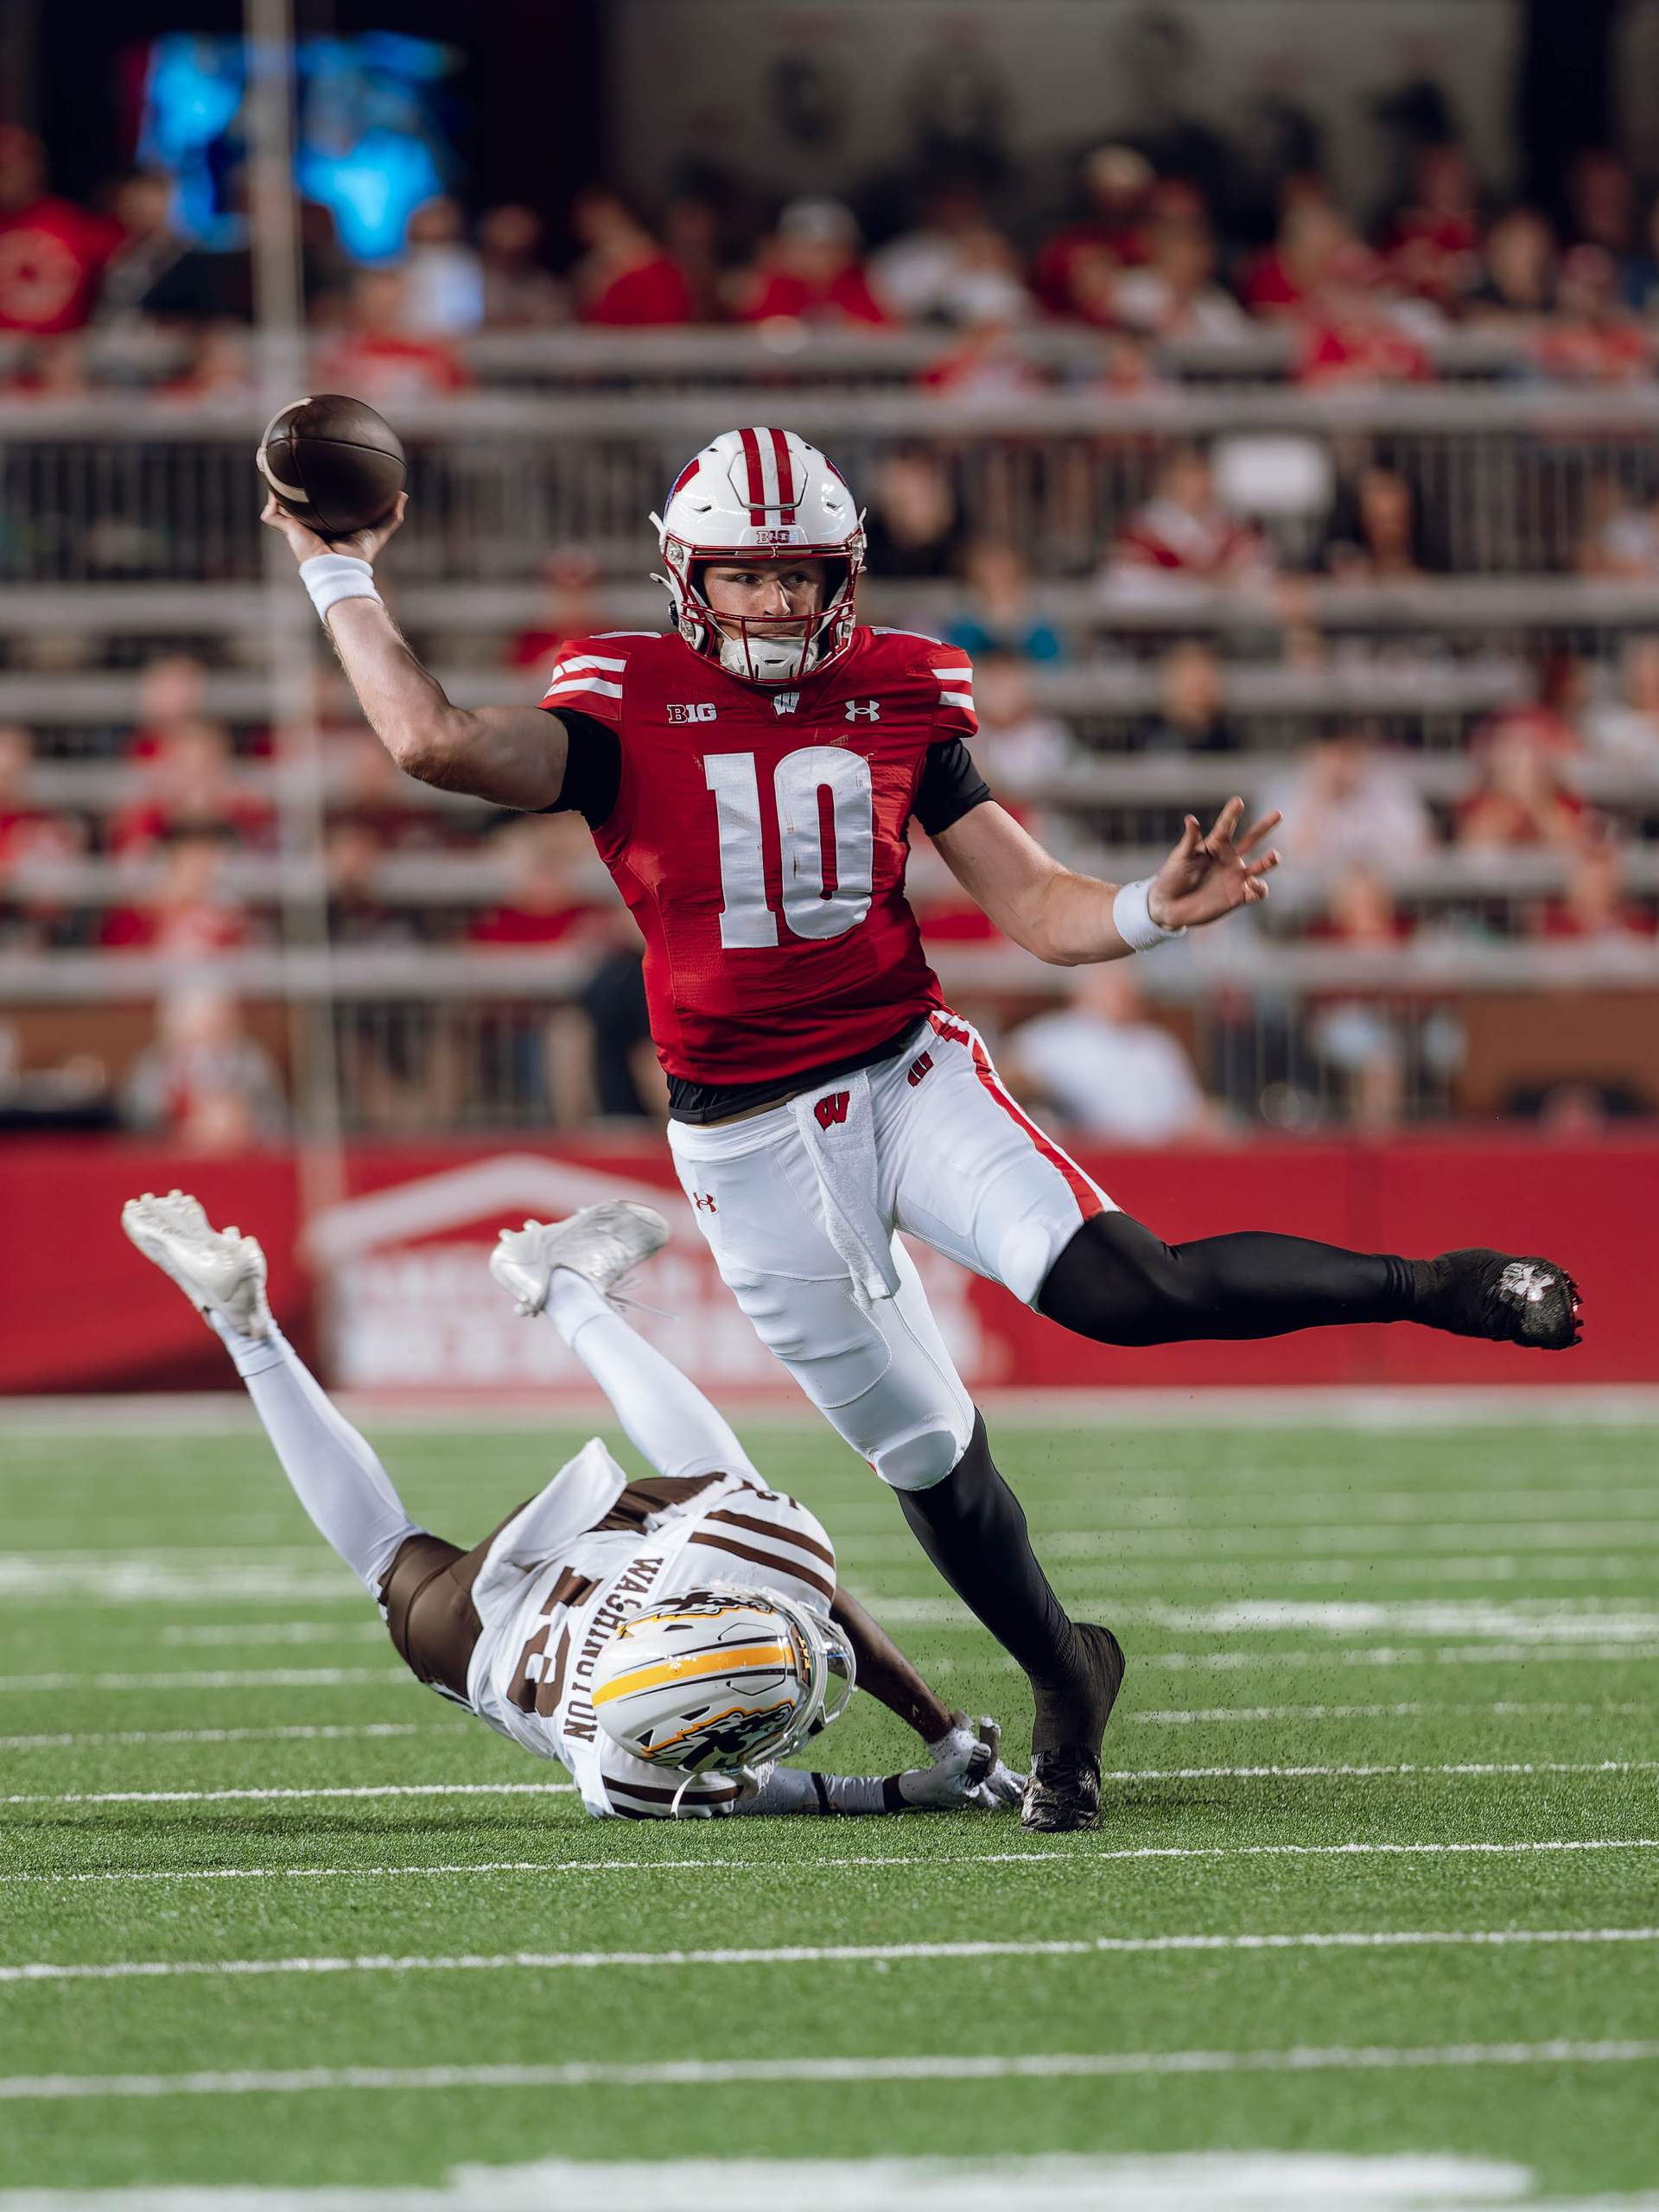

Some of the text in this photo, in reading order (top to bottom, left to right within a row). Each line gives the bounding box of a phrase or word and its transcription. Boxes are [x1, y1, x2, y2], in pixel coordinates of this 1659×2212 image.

[773, 691, 800, 716] W
[703, 746, 873, 950] 10
[814, 1090, 849, 1131] W
